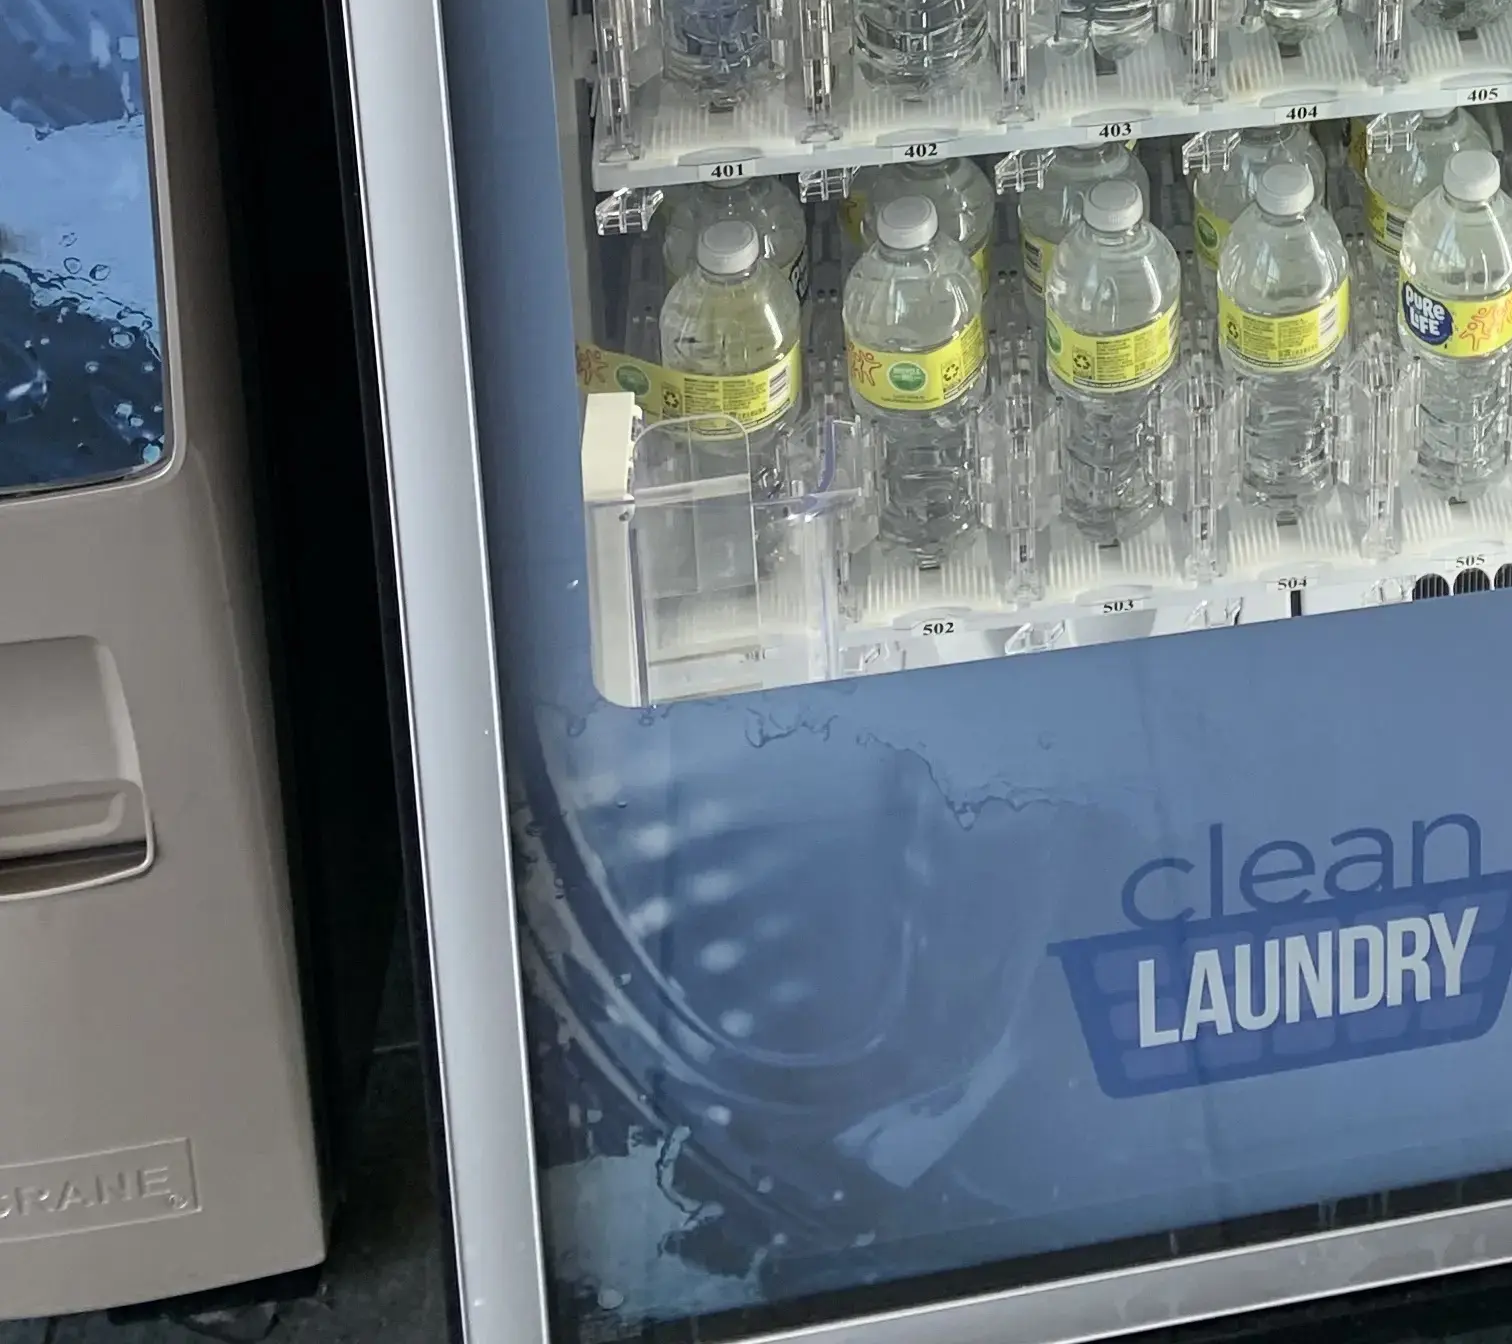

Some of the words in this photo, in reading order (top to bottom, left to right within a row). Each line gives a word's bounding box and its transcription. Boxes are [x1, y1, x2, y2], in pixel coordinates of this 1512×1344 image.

[1467, 87, 1500, 102] 405
[1285, 105, 1319, 121] 404
[1098, 122, 1133, 139] 403
[904, 143, 939, 159] 402
[711, 161, 745, 178] 401
[1455, 555, 1486, 569] 505
[1277, 577, 1309, 591] 504
[1102, 599, 1135, 614] 503
[922, 621, 955, 637] 502
[1121, 812, 1483, 928] clean
[1138, 907, 1480, 1048] LAUNDRY
